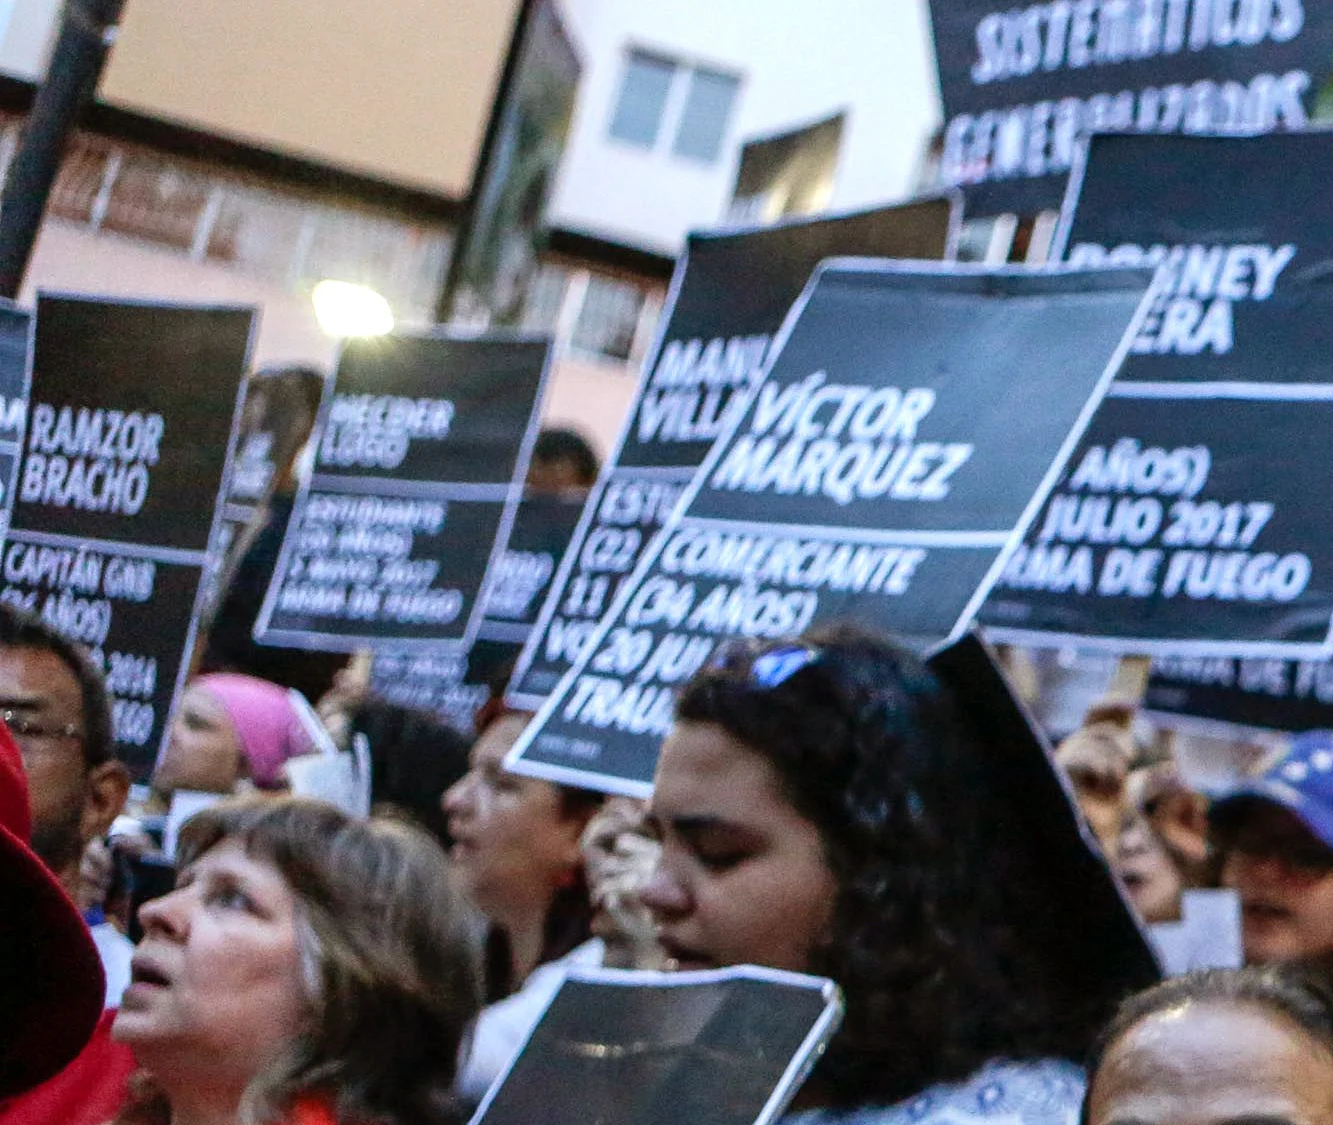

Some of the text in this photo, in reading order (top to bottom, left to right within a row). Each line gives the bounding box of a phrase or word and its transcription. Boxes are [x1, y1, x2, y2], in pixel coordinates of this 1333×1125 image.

[30, 402, 166, 467] RAMZOR
[751, 369, 937, 442] VÍCTOR
[22, 453, 150, 517] BRACHO
[1069, 436, 1211, 498] AÑOS)
[1038, 493, 1276, 549] JULIO 2017
[4, 544, 104, 596] CAPITÁN
[660, 525, 929, 596] COMERCIANTE
[1100, 547, 1164, 598] DE
[1161, 551, 1313, 602] FUEGO
[625, 574, 819, 640] (34 AÑOS)
[591, 627, 654, 676] 20
